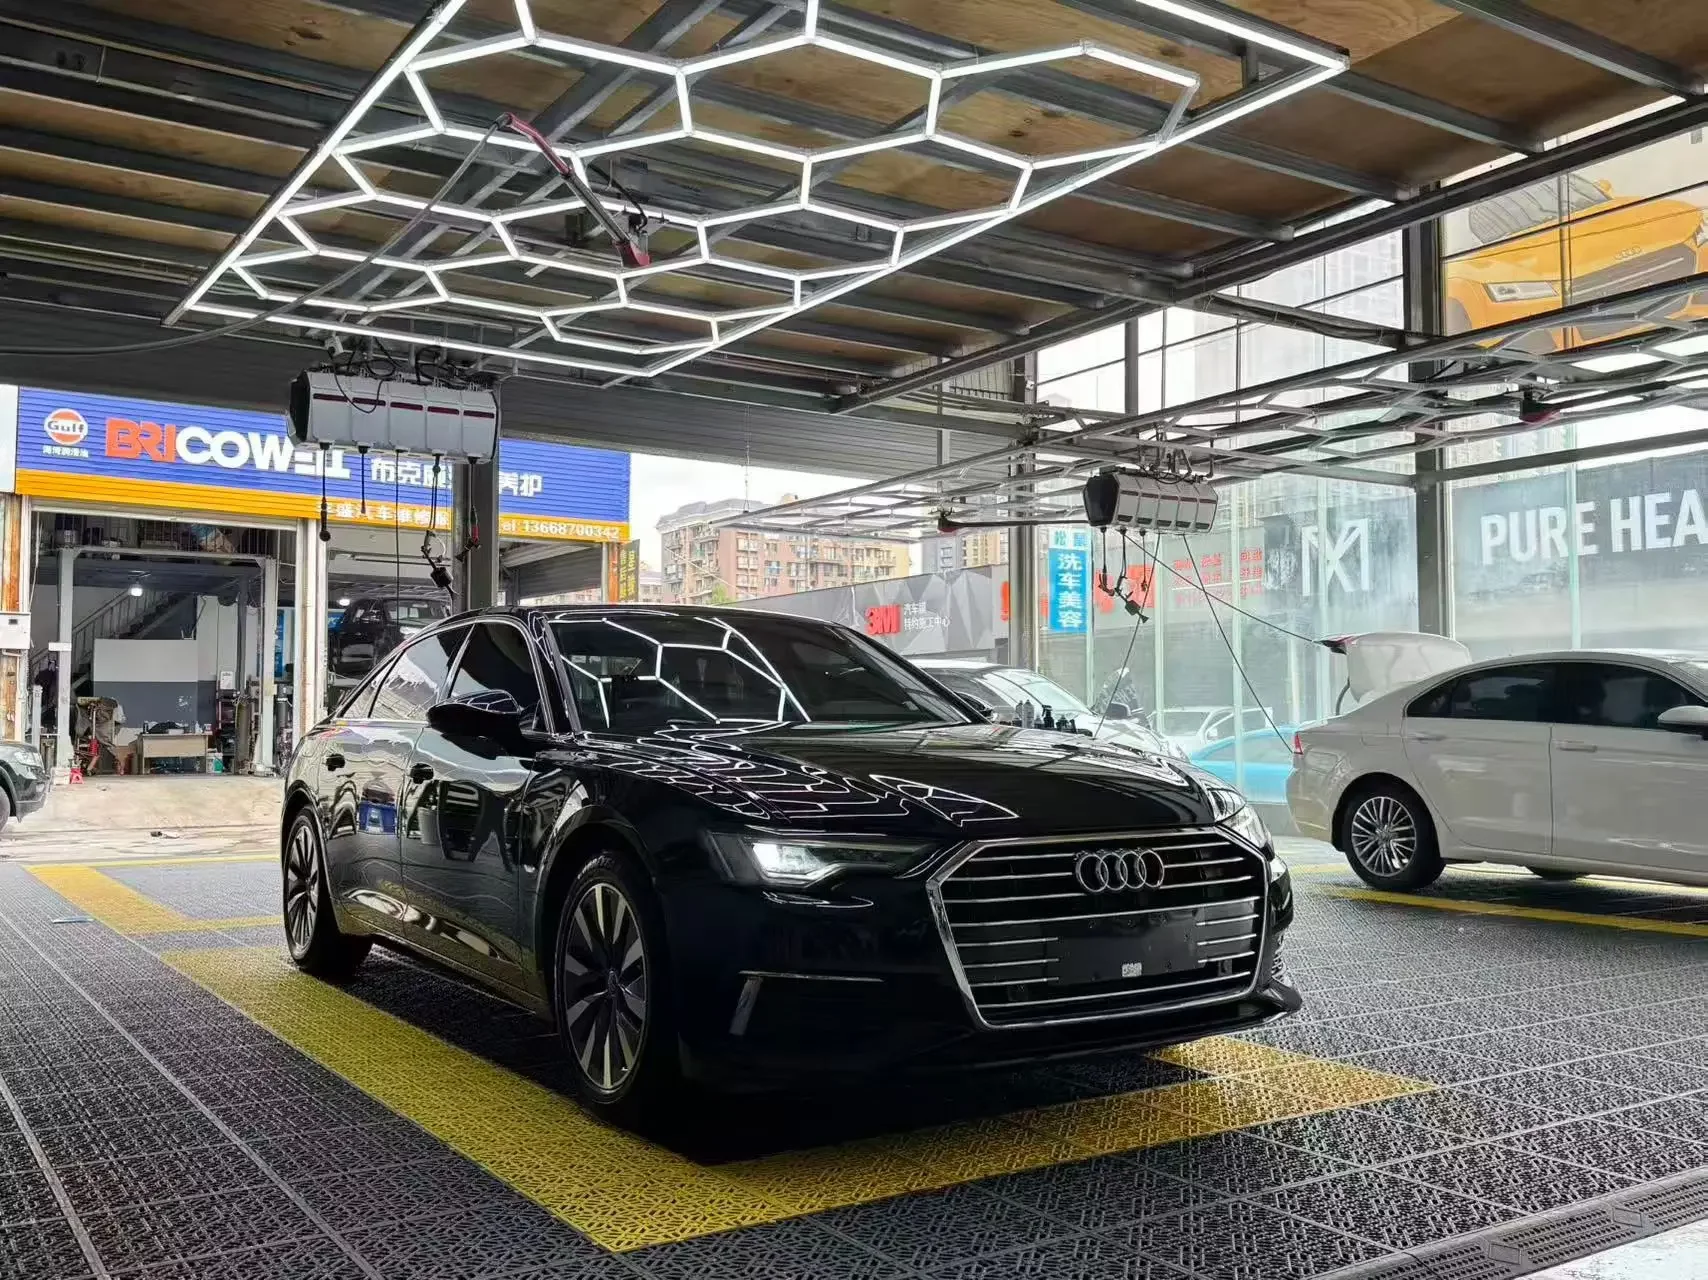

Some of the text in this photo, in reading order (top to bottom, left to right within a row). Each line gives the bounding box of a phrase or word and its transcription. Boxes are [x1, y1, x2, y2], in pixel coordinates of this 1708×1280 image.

[47, 420, 85, 433] Gulf
[1480, 489, 1708, 566] PURE HEA
[1057, 553, 1083, 628] 洗车美容
[866, 604, 900, 635] 3M
